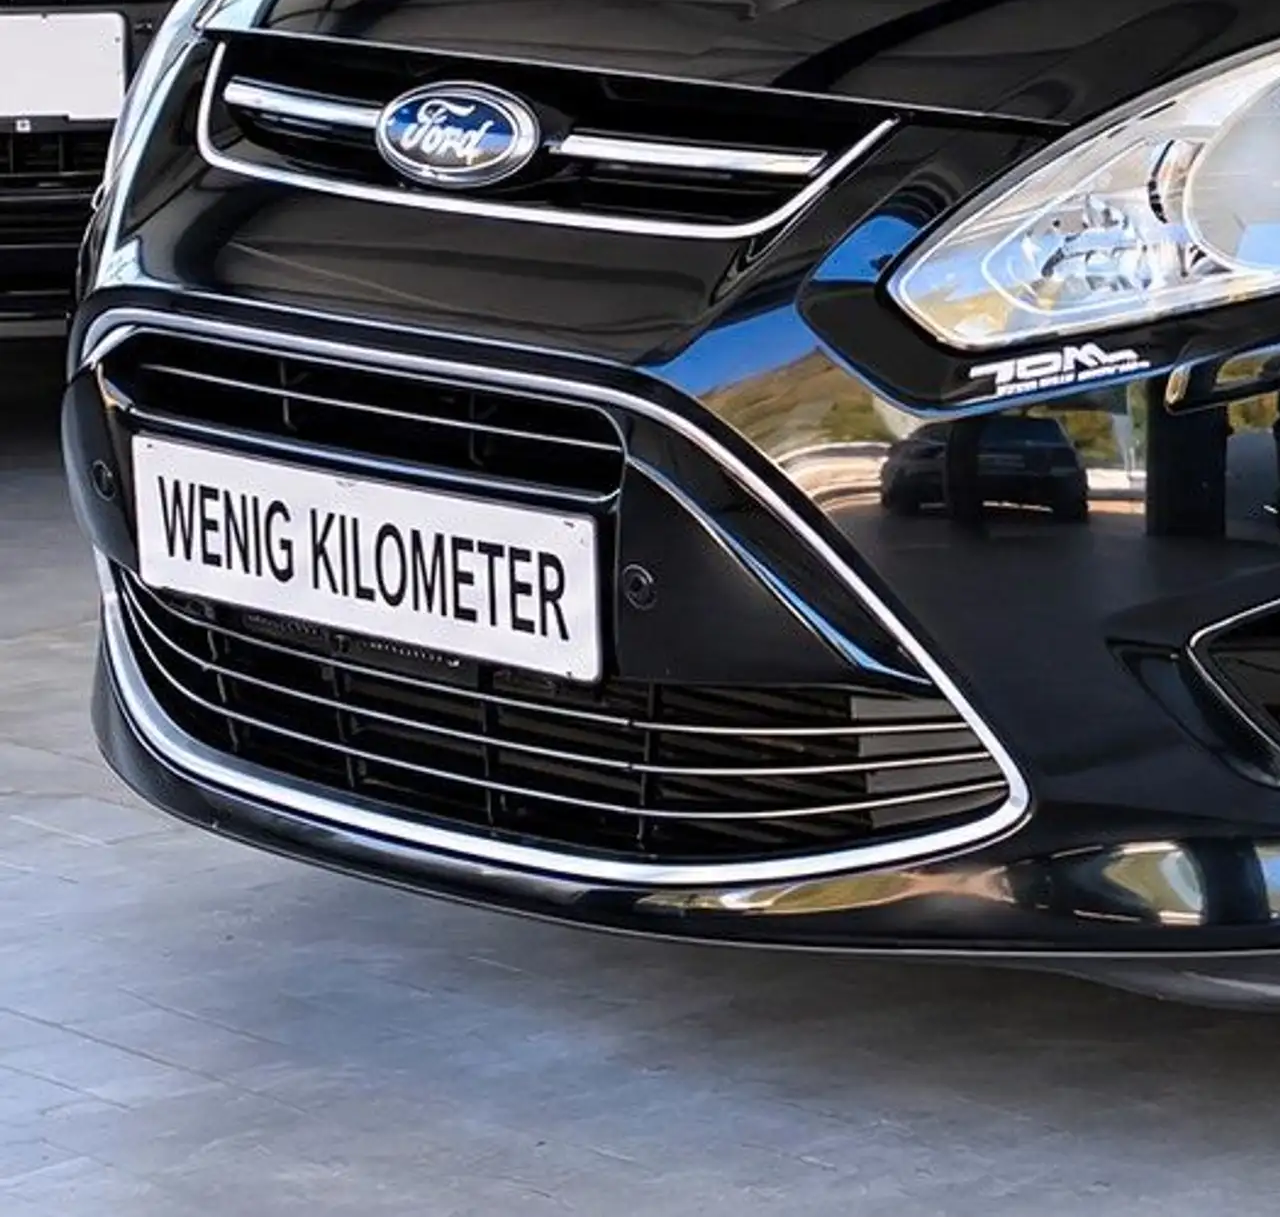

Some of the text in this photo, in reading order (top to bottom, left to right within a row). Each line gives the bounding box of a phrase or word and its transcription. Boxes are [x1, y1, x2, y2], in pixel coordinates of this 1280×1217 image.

[401, 98, 495, 160] Ford
[157, 475, 294, 583] WENIG
[309, 508, 570, 641] KILOMETER
